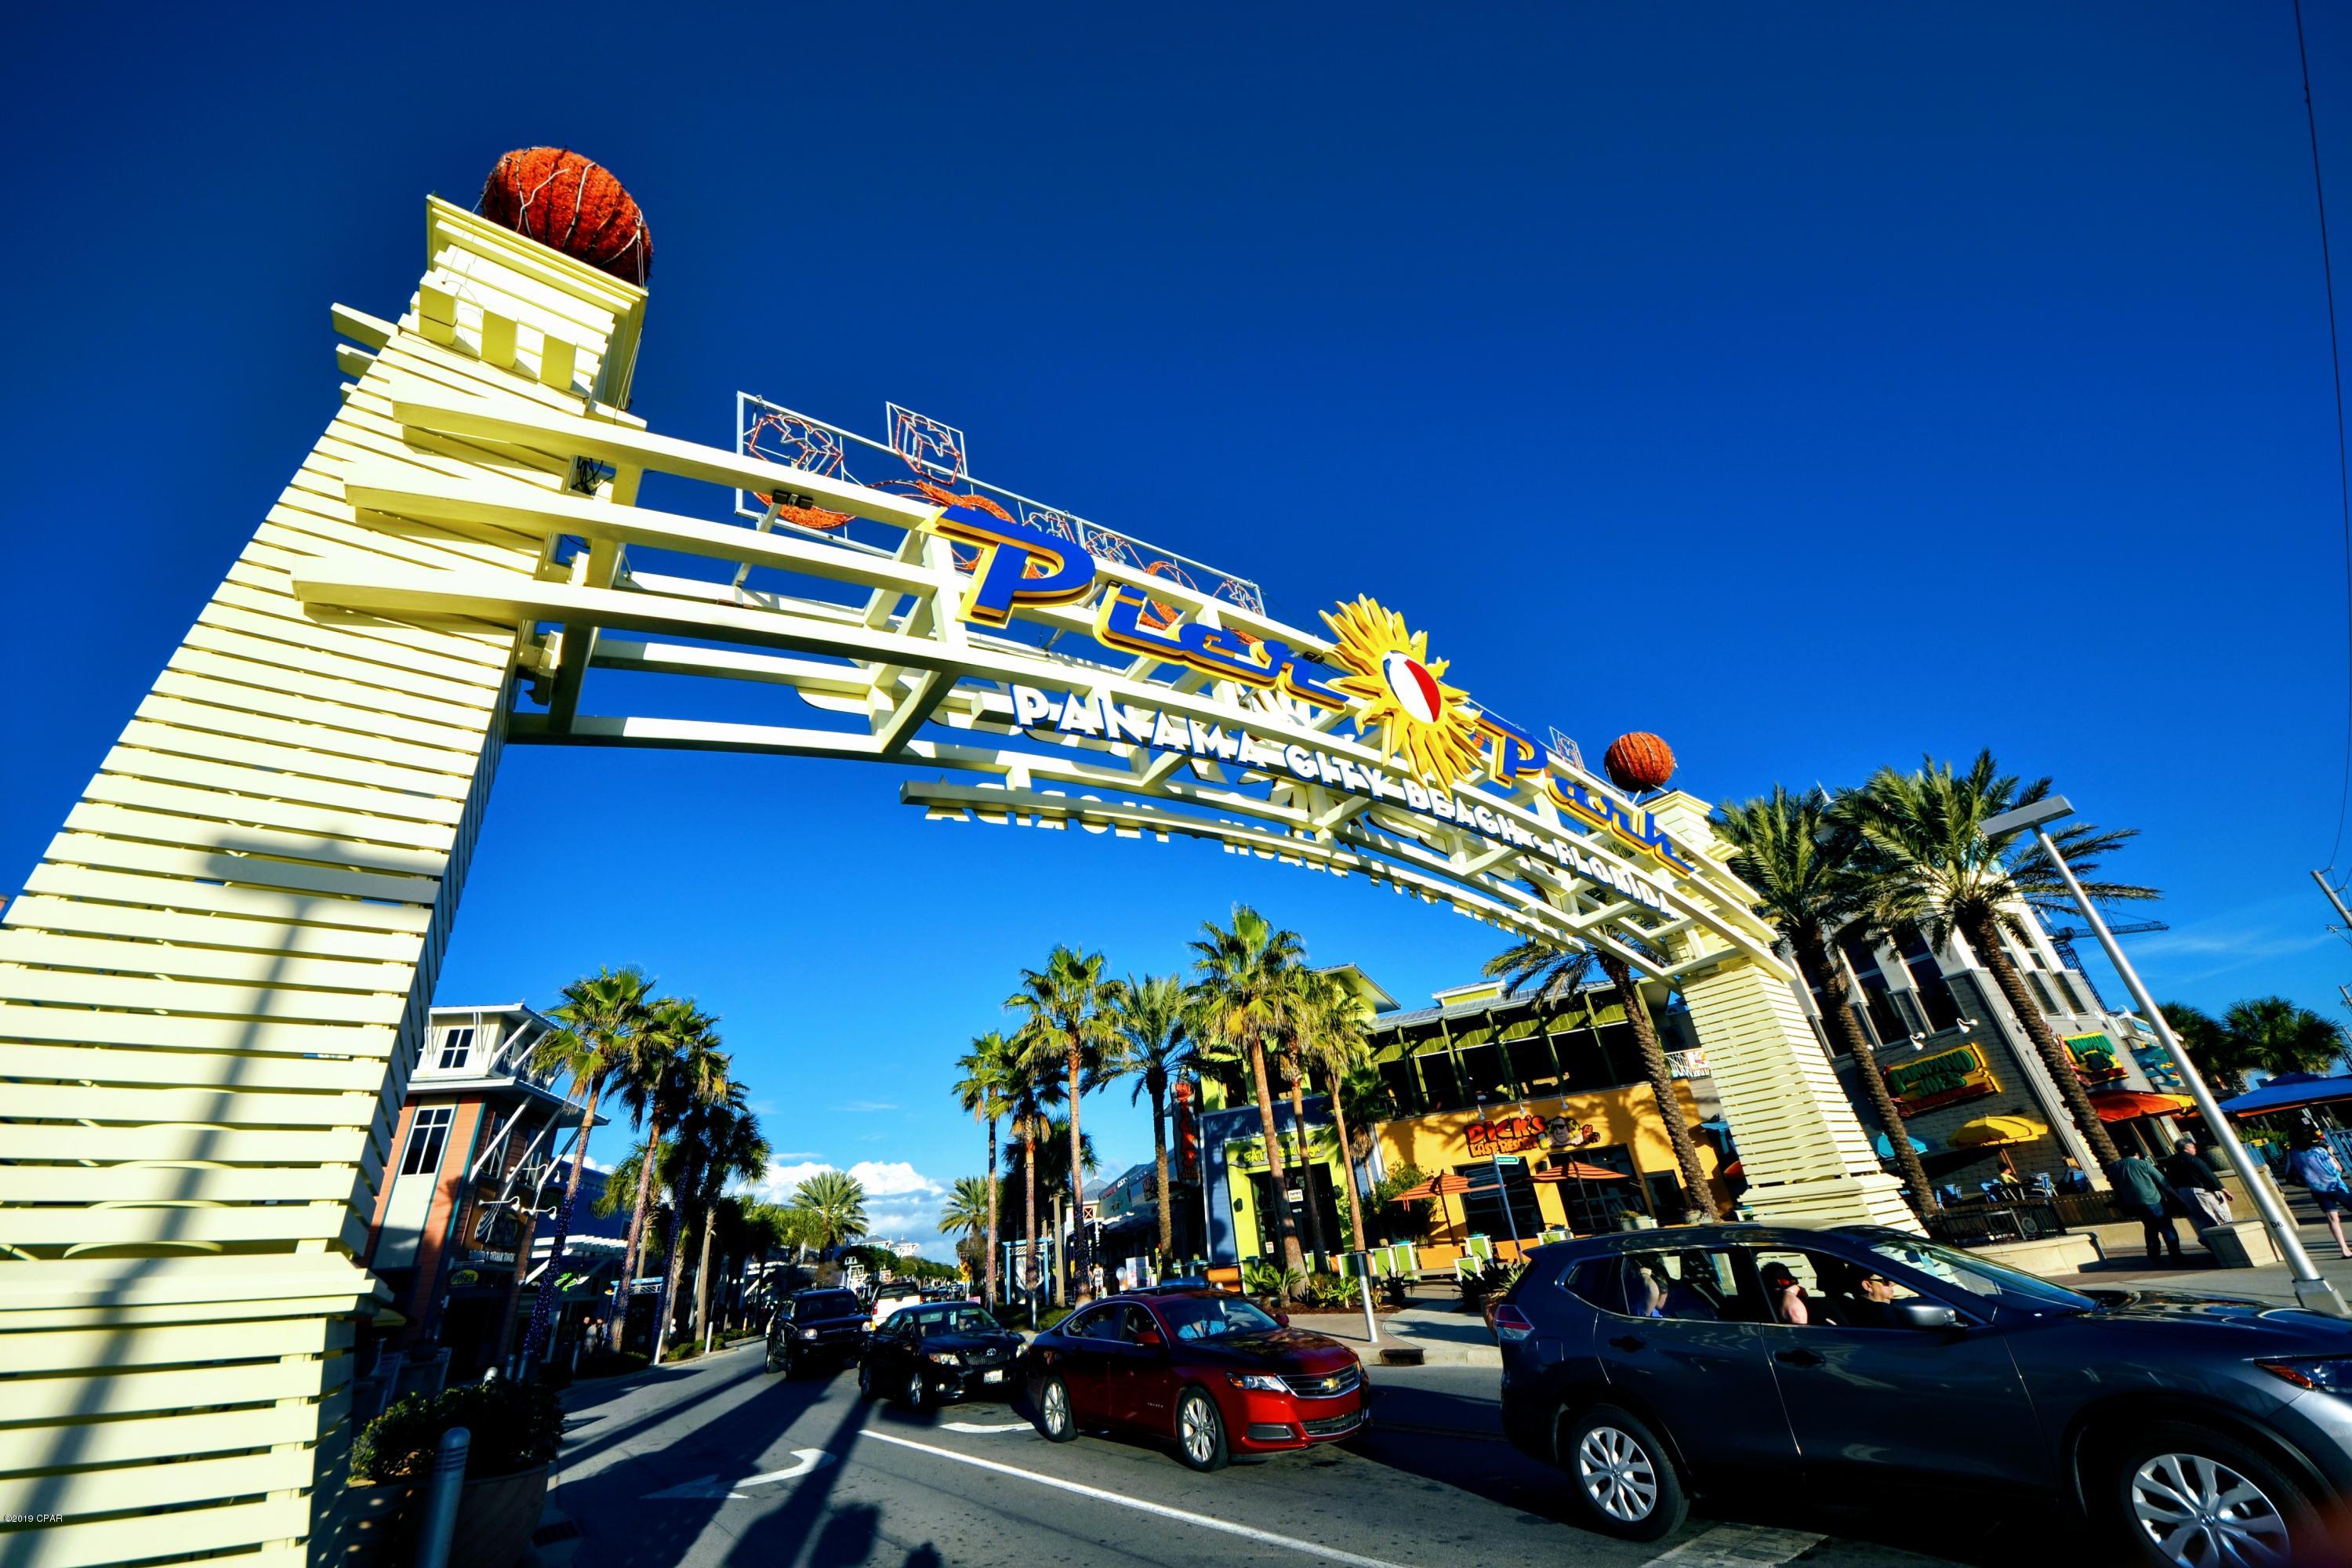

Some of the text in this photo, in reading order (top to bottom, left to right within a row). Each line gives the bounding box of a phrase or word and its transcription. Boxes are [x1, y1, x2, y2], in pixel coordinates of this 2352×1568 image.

[916, 504, 1696, 880] Pier Park
[1011, 683, 1268, 772] PANAMA
[1283, 743, 1383, 800] CITY
[1401, 778, 1524, 849] BEACH
[1552, 837, 1680, 921] FLORIDA
[1888, 1048, 1976, 1094] POMPANO
[1464, 1115, 1545, 1144] DICK'S
[1468, 1141, 1499, 1157] LAST
